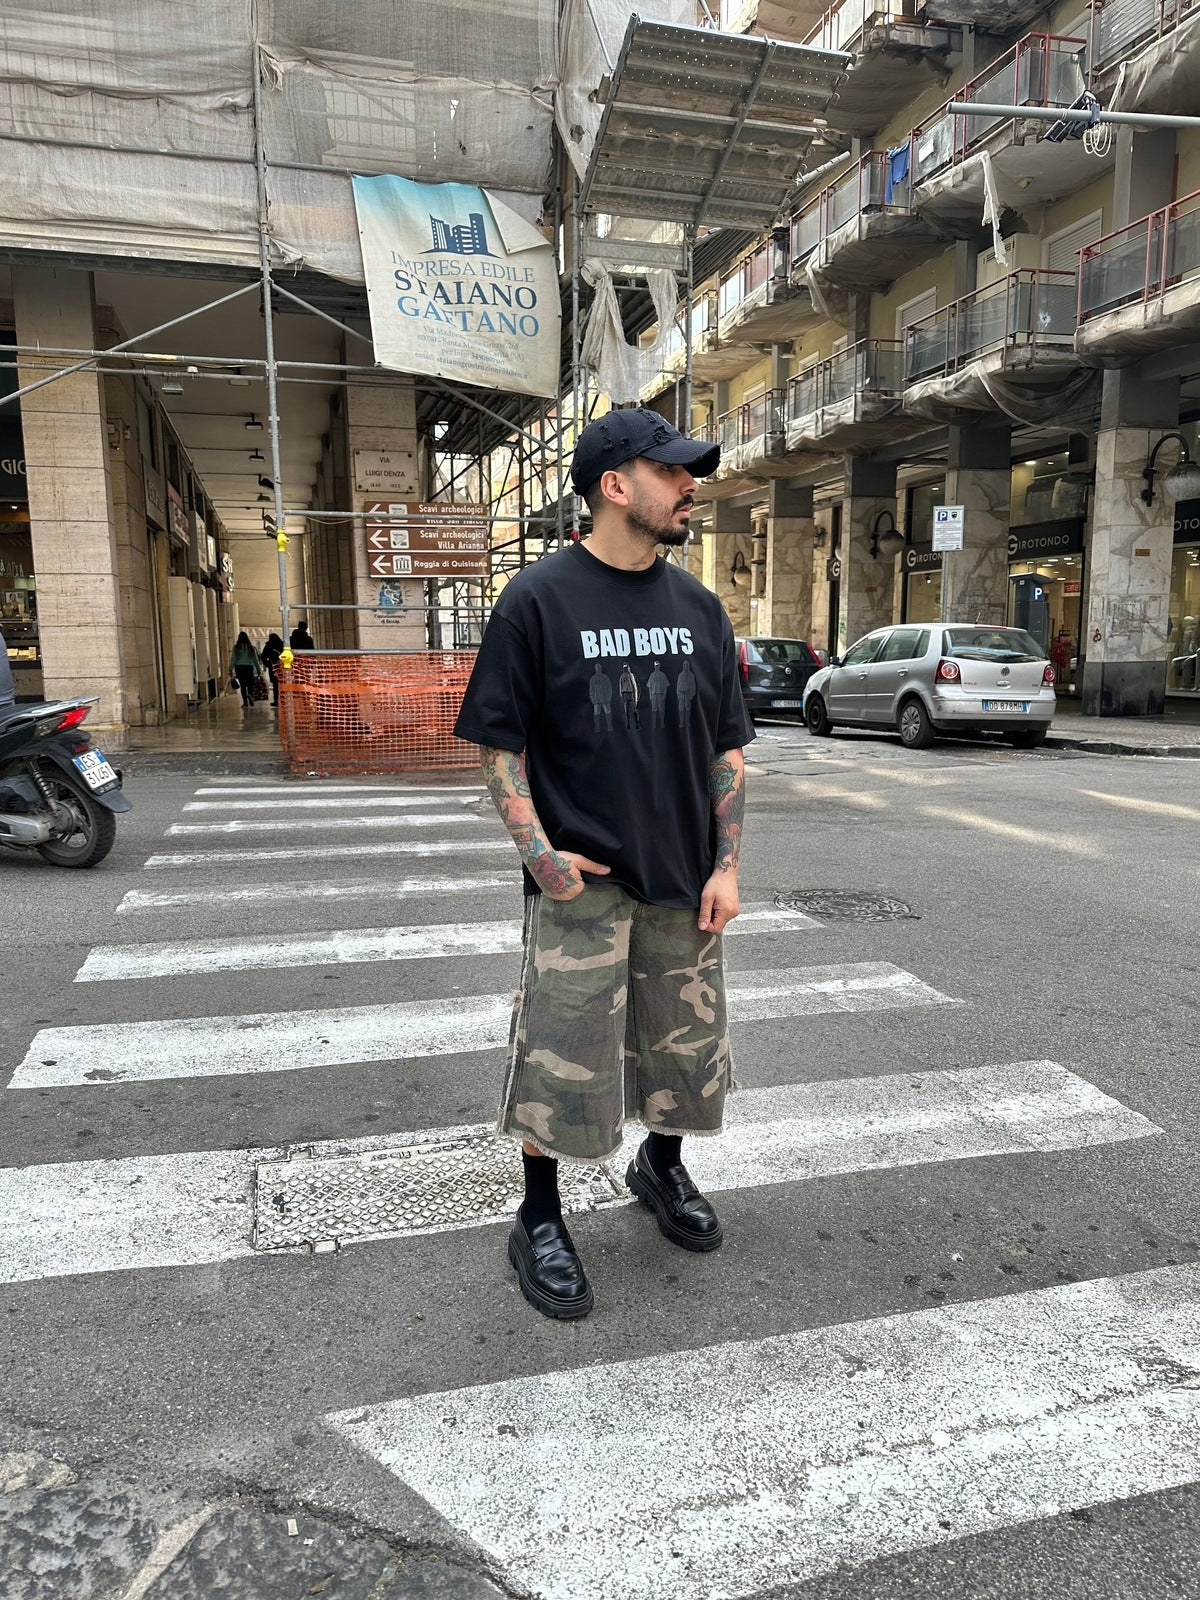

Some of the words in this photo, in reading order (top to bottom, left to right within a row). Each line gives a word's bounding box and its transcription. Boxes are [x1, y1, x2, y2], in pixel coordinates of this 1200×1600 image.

[391, 250, 476, 277] IMPRESA
[480, 261, 535, 283] EDILE
[394, 269, 537, 310] STAIANO
[397, 295, 539, 338] GAETANO
[418, 504, 438, 513] Scavi
[440, 505, 484, 515] archeologici
[420, 530, 439, 539] Scavi
[441, 530, 484, 540] archeologici
[437, 541, 455, 549] Villa
[458, 541, 484, 549] Arianna
[1007, 534, 1070, 556] GIROTONDO
[414, 560, 440, 569] Reggia
[441, 560, 450, 568] di
[451, 560, 488, 568] Quisisana
[1034, 587, 1043, 600] P
[580, 628, 631, 659] BAD
[632, 627, 694, 657] BOYS
[80, 754, 96, 768] ES
